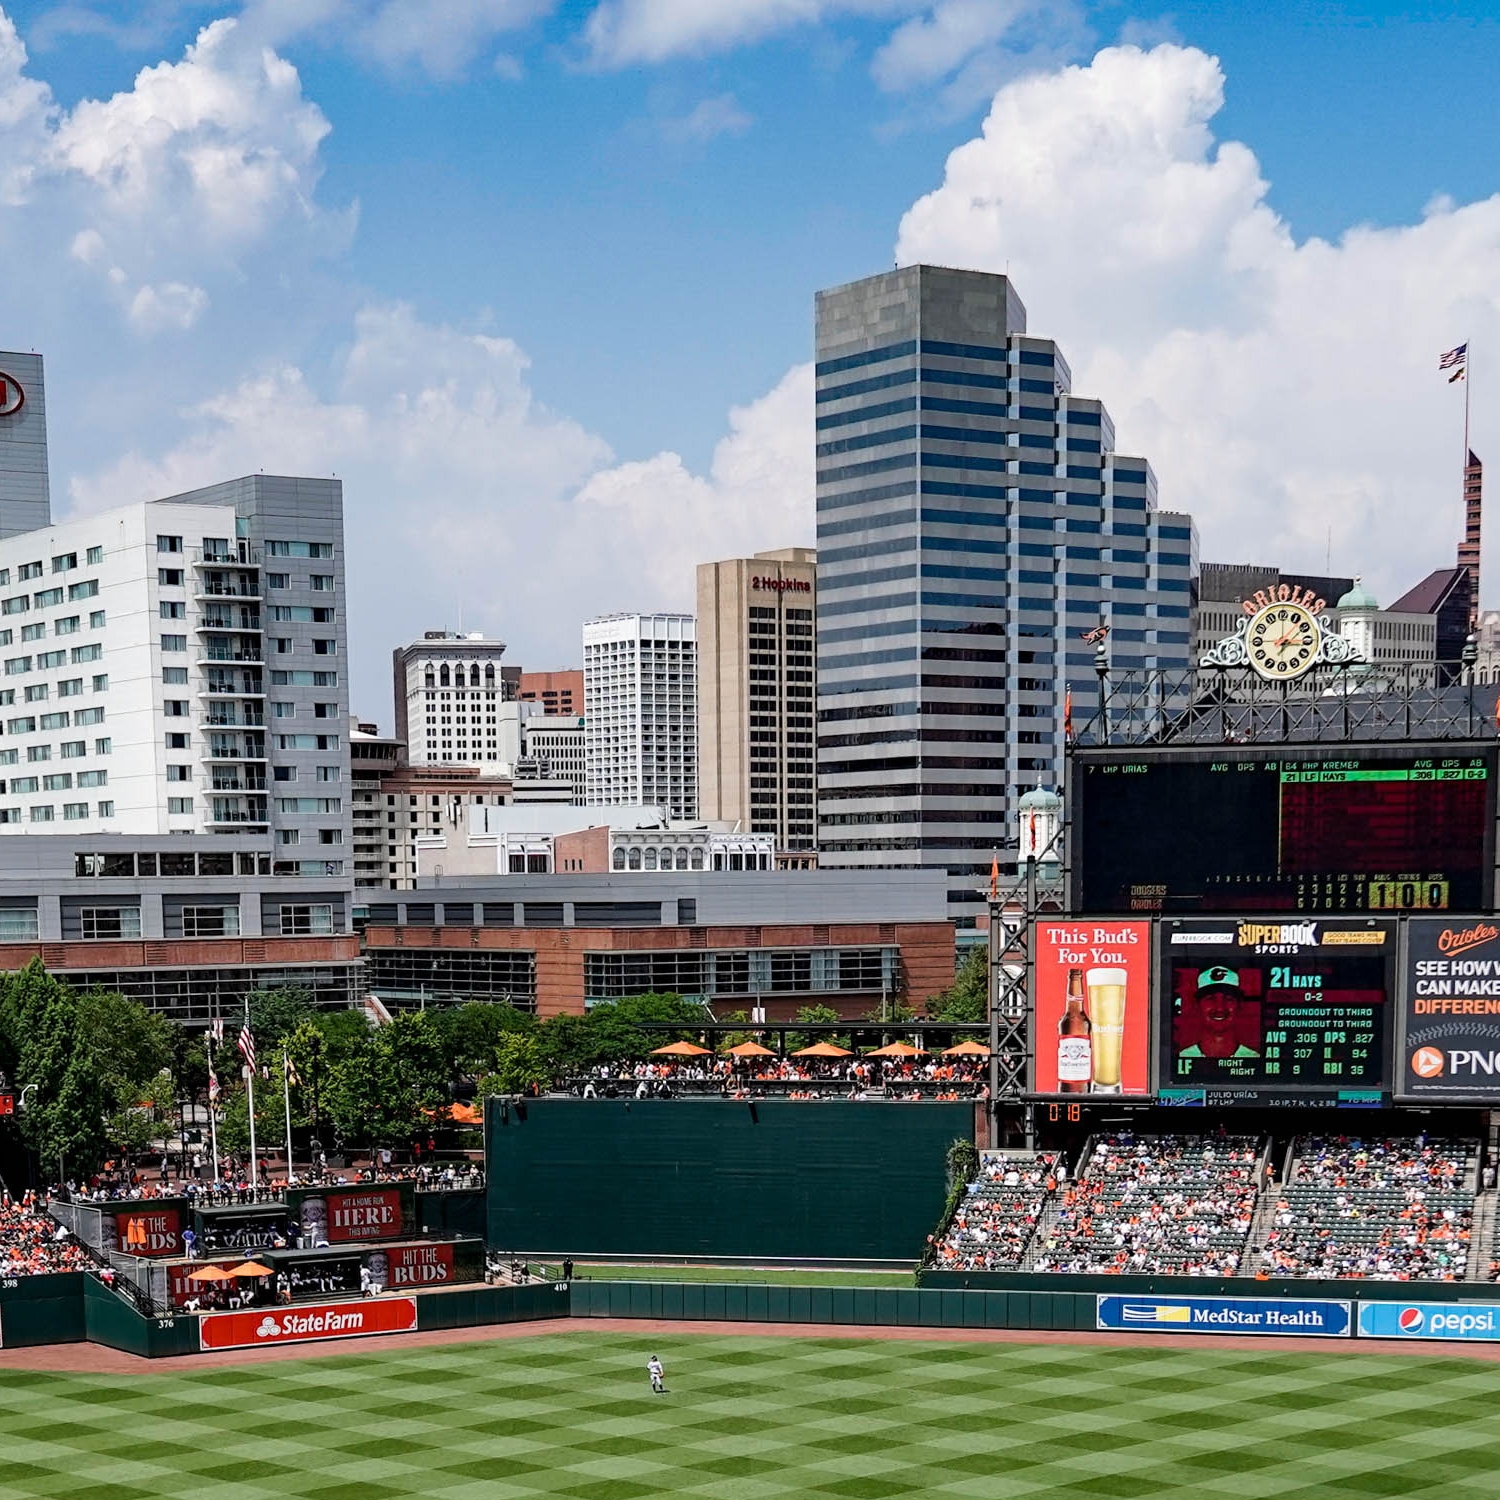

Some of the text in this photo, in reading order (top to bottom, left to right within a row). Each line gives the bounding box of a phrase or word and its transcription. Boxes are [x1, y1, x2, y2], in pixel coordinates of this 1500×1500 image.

[752, 576, 811, 593] 2 Hopkins
[1242, 583, 1327, 616] ORIOLES
[1211, 763, 1228, 772] AVG
[1237, 763, 1255, 771] OPS
[1323, 761, 1360, 770] KREMER
[1414, 759, 1483, 768] AVG OPS AB
[1304, 772, 1346, 781] LF HAYS
[1378, 884, 1386, 907] 1
[1402, 884, 1414, 907] 0
[1429, 884, 1441, 907] 0
[1047, 928, 1139, 944] This Bud's
[1238, 922, 1320, 954] SUPERBOOK SPORTS
[1438, 922, 1500, 956] Orioles
[1058, 948, 1128, 964] For You.
[1415, 960, 1449, 976] SEE
[1451, 960, 1492, 976] HOW
[1270, 967, 1322, 988] 21 HAYS
[1416, 980, 1450, 995] CAN
[1304, 993, 1323, 1001] 0-2
[1278, 1008, 1373, 1016] GROUNDOUT TO THIRD
[1278, 1020, 1373, 1028] GROUNDOUT TO THIRD
[1266, 1031, 1318, 1043] AVG .306
[1324, 1031, 1374, 1043] OPS .827
[1265, 1047, 1313, 1059] AB 307
[1352, 1049, 1368, 1058] 94
[1177, 1059, 1193, 1075] LF
[1230, 1067, 1256, 1075] RIGHT
[1265, 1062, 1280, 1074] HR
[1323, 1062, 1364, 1074] RBI 36
[1049, 1104, 1080, 1121] 0:18
[148, 1216, 167, 1232] THE
[334, 1206, 394, 1227] HERE
[402, 1247, 438, 1265] HIT THE
[394, 1263, 447, 1284] BUDS
[2, 1279, 18, 1289] 398
[554, 1283, 568, 1291] 410
[158, 1320, 174, 1328] 376
[1194, 1308, 1324, 1326] MedStar Health
[1430, 1310, 1494, 1333] pepsi
